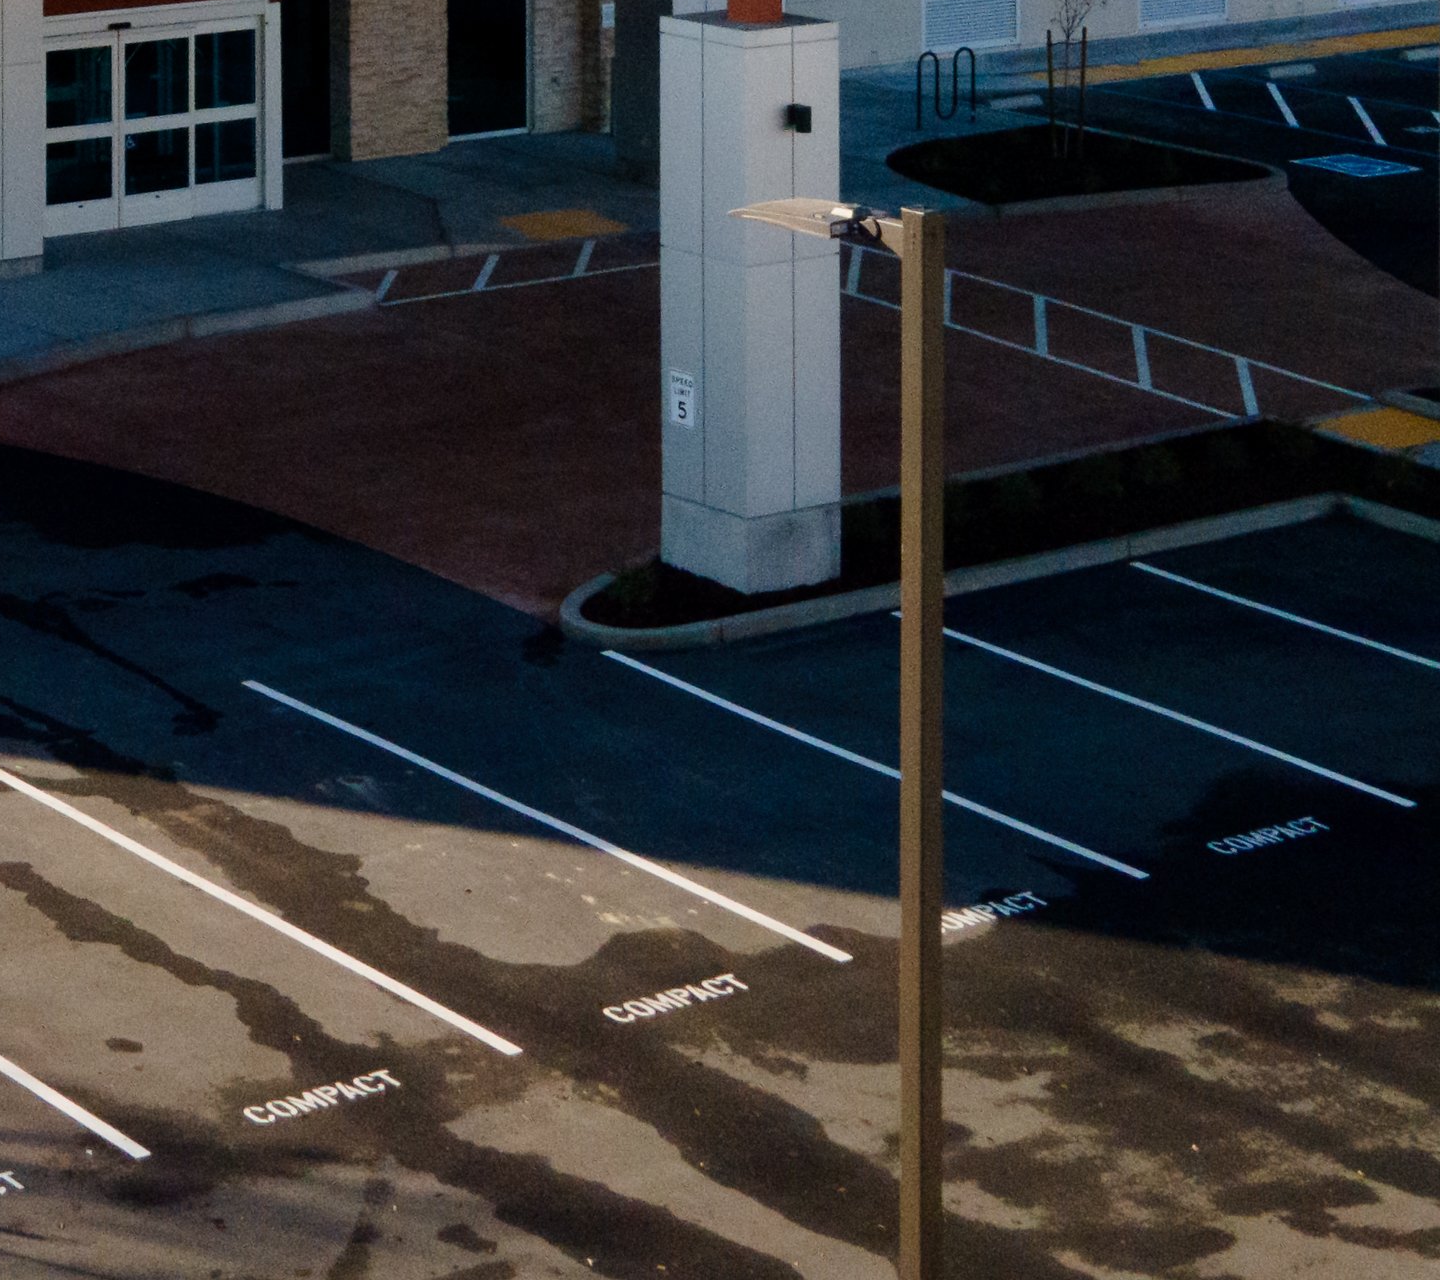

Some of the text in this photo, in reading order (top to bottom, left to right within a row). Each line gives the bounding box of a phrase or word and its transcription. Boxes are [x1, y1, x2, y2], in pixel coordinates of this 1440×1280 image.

[678, 400, 688, 419] 5
[1206, 815, 1331, 855] COMPACT
[940, 891, 1048, 934] OMPACT
[602, 972, 749, 1023] COMPACT
[242, 1069, 401, 1124] COMPACT
